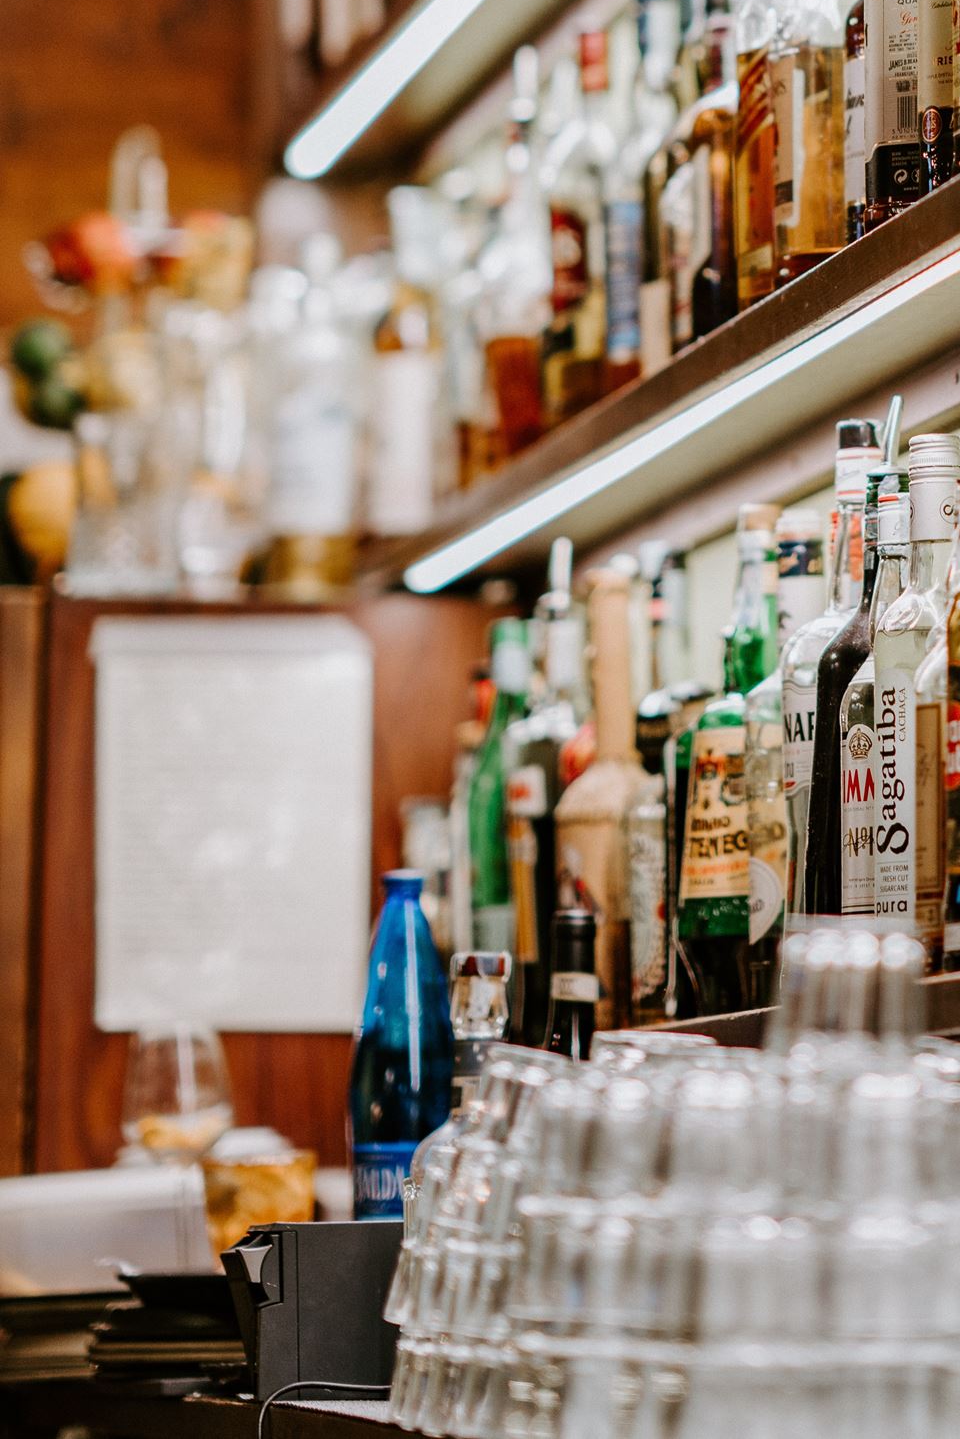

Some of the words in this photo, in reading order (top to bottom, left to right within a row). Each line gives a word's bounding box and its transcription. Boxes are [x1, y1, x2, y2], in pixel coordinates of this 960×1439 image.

[877, 687, 909, 854] Sagatiba
[892, 864, 909, 872] FROM
[897, 874, 909, 882] CUT
[880, 884, 908, 893] SUGARCANE
[876, 900, 908, 917] pura
